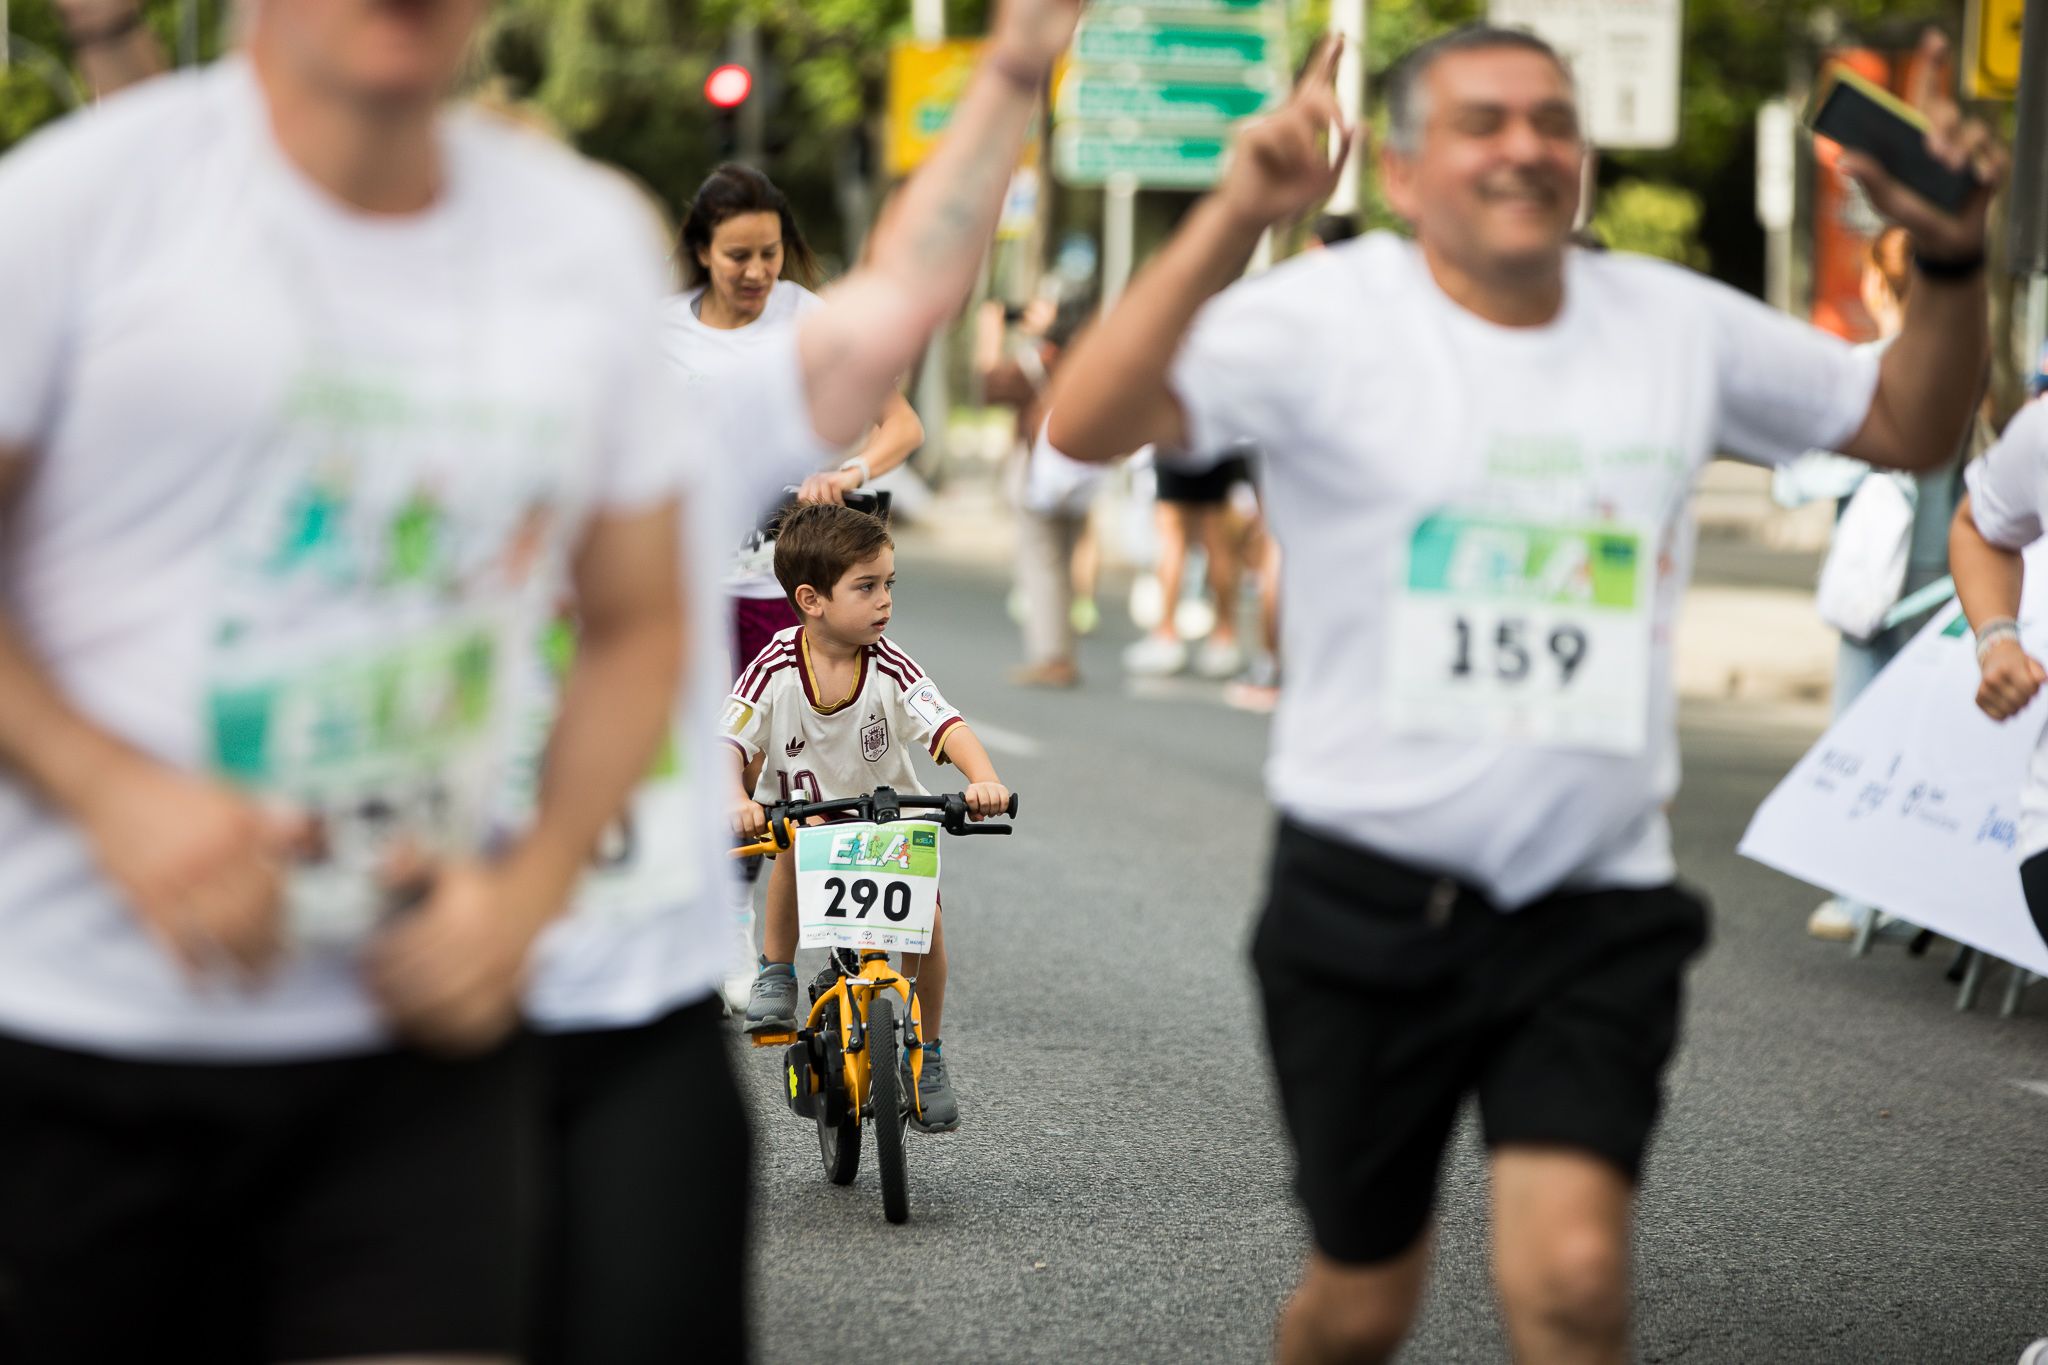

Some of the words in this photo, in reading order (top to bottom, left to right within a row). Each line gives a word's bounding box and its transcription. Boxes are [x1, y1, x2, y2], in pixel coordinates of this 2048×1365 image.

[1452, 615, 1590, 687] 159
[776, 769, 822, 803] 10
[828, 832, 910, 869] ELA
[824, 877, 911, 922] 290
